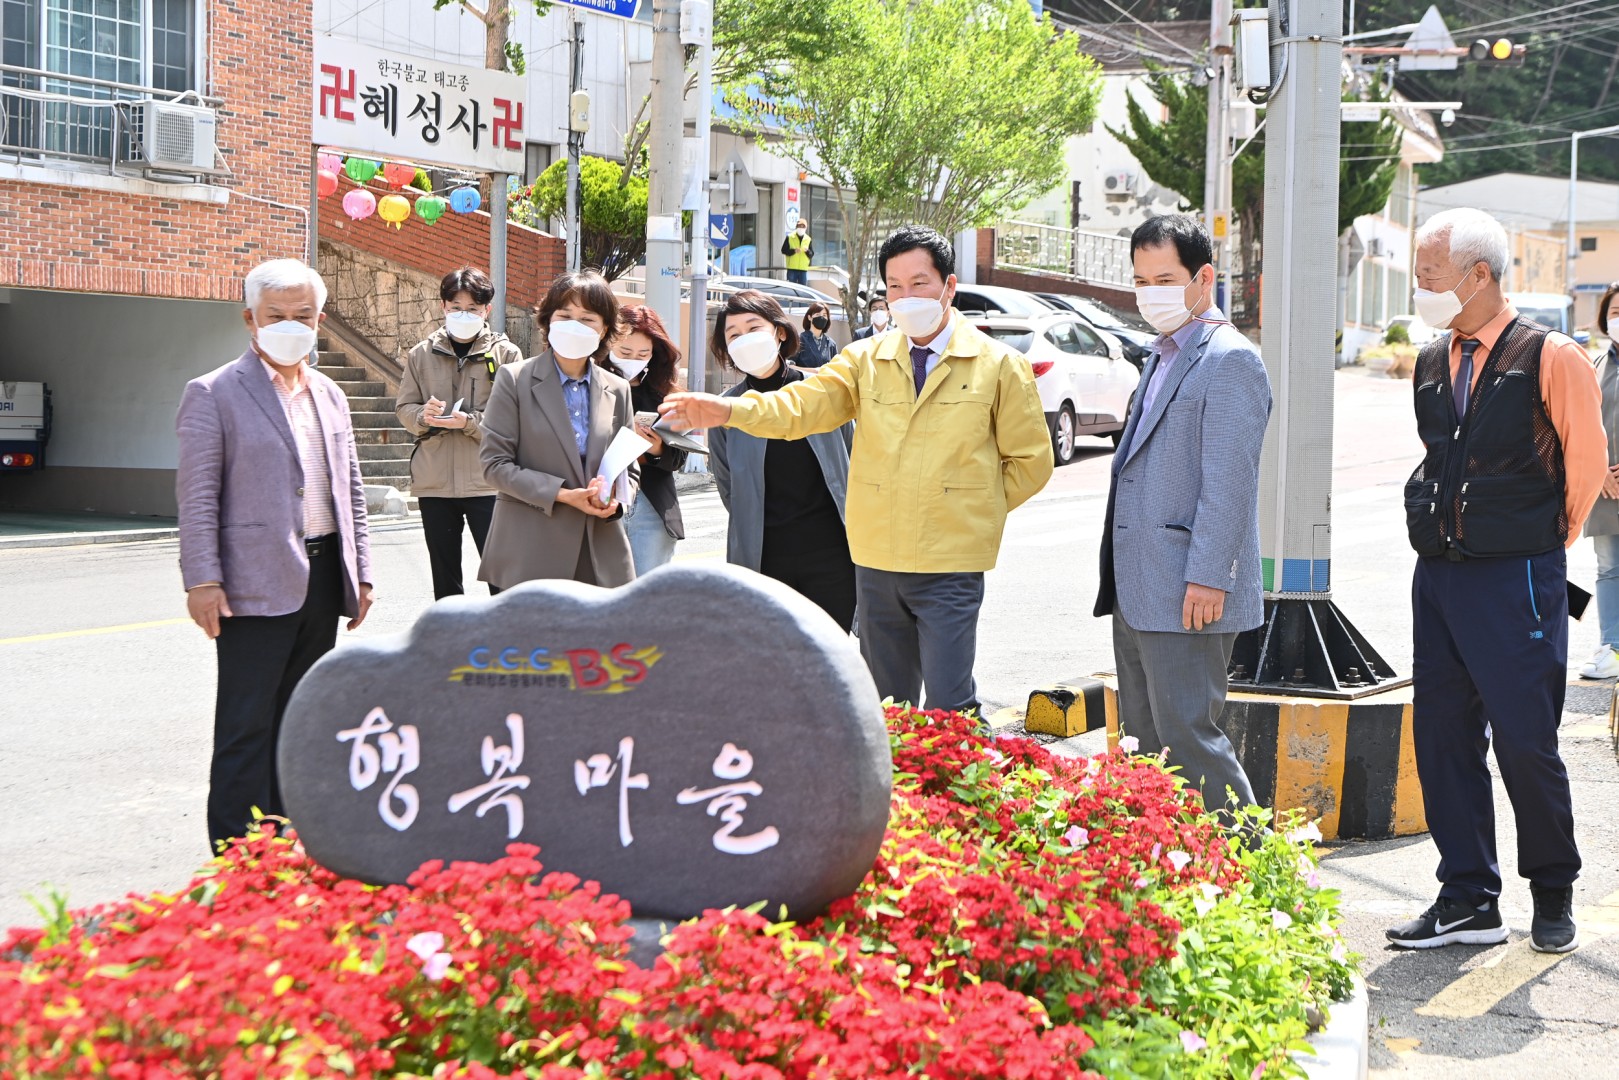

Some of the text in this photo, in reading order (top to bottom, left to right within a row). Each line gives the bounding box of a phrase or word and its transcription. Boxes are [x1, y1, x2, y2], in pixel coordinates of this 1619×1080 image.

[377, 58, 470, 93] 한국불교 태고종
[359, 82, 488, 151] 혜성사
